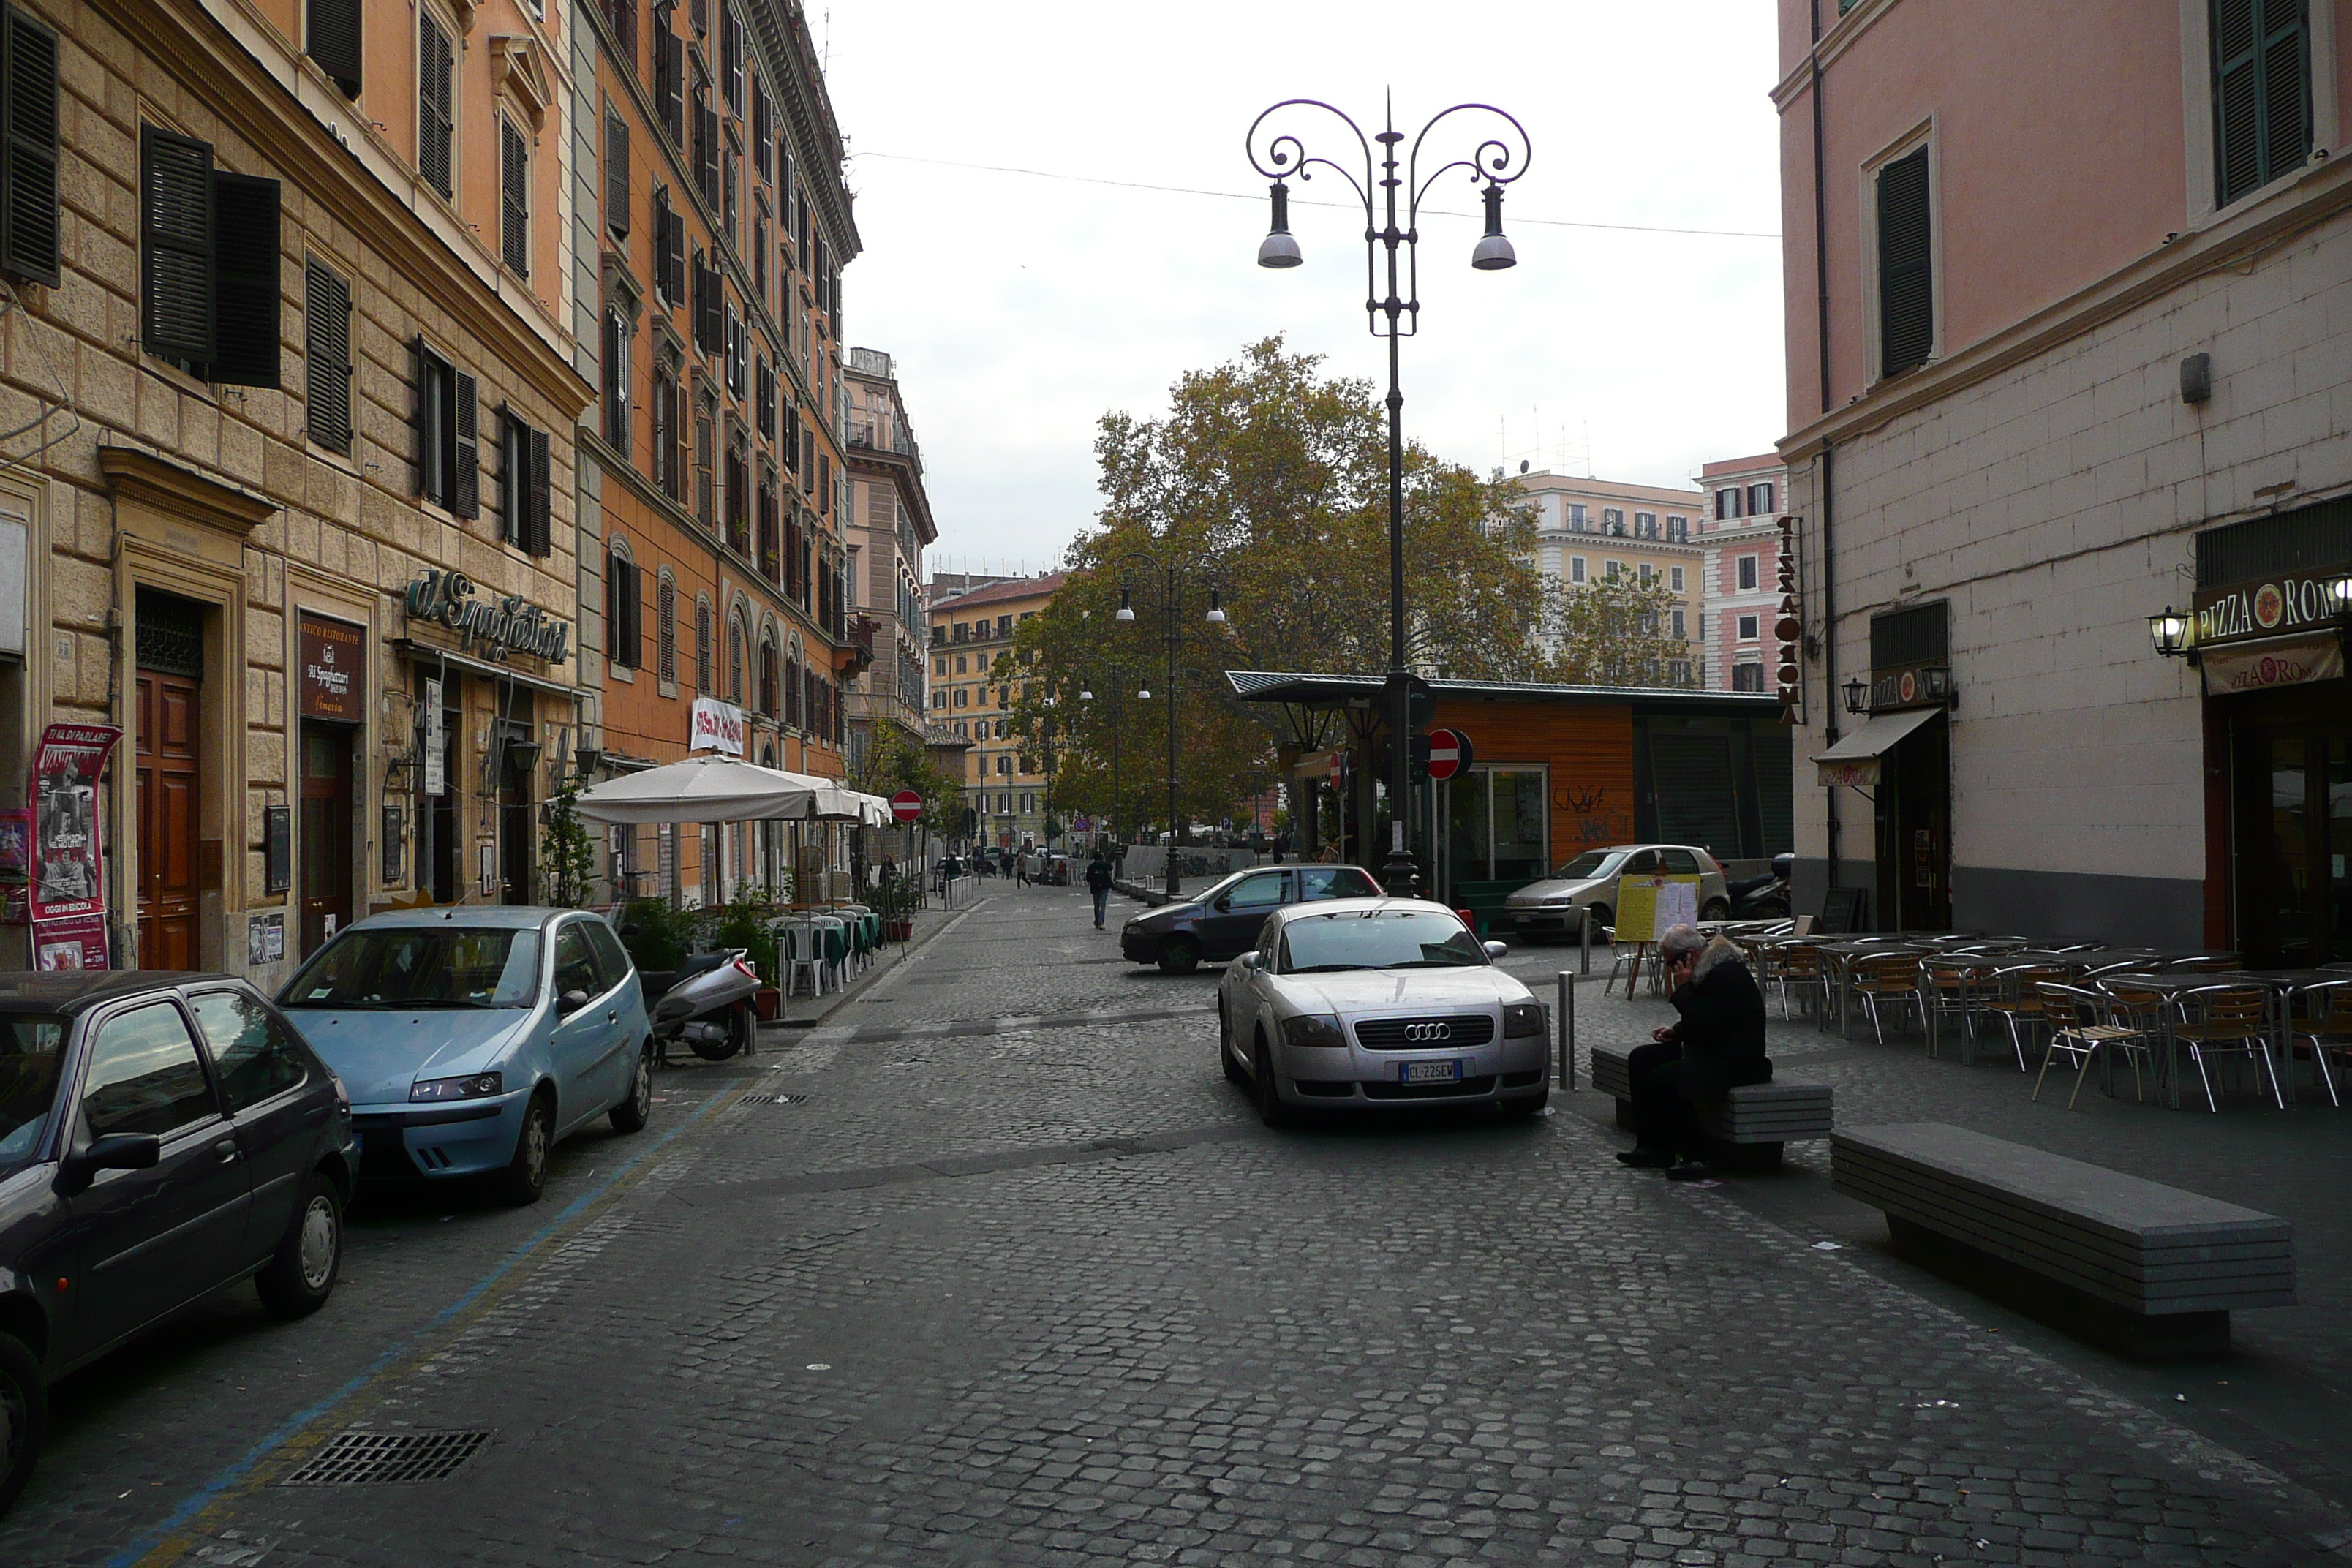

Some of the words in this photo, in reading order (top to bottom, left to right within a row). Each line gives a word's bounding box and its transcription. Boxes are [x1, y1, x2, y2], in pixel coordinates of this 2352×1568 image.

[2200, 589, 2253, 640] PIZZA
[2283, 579, 2336, 625] ROM
[299, 622, 322, 637] ANTICO
[323, 627, 359, 645] RISTORANTE
[1873, 674, 1899, 707] PIZZA
[45, 905, 61, 914] OGGI
[61, 904, 69, 913] IN
